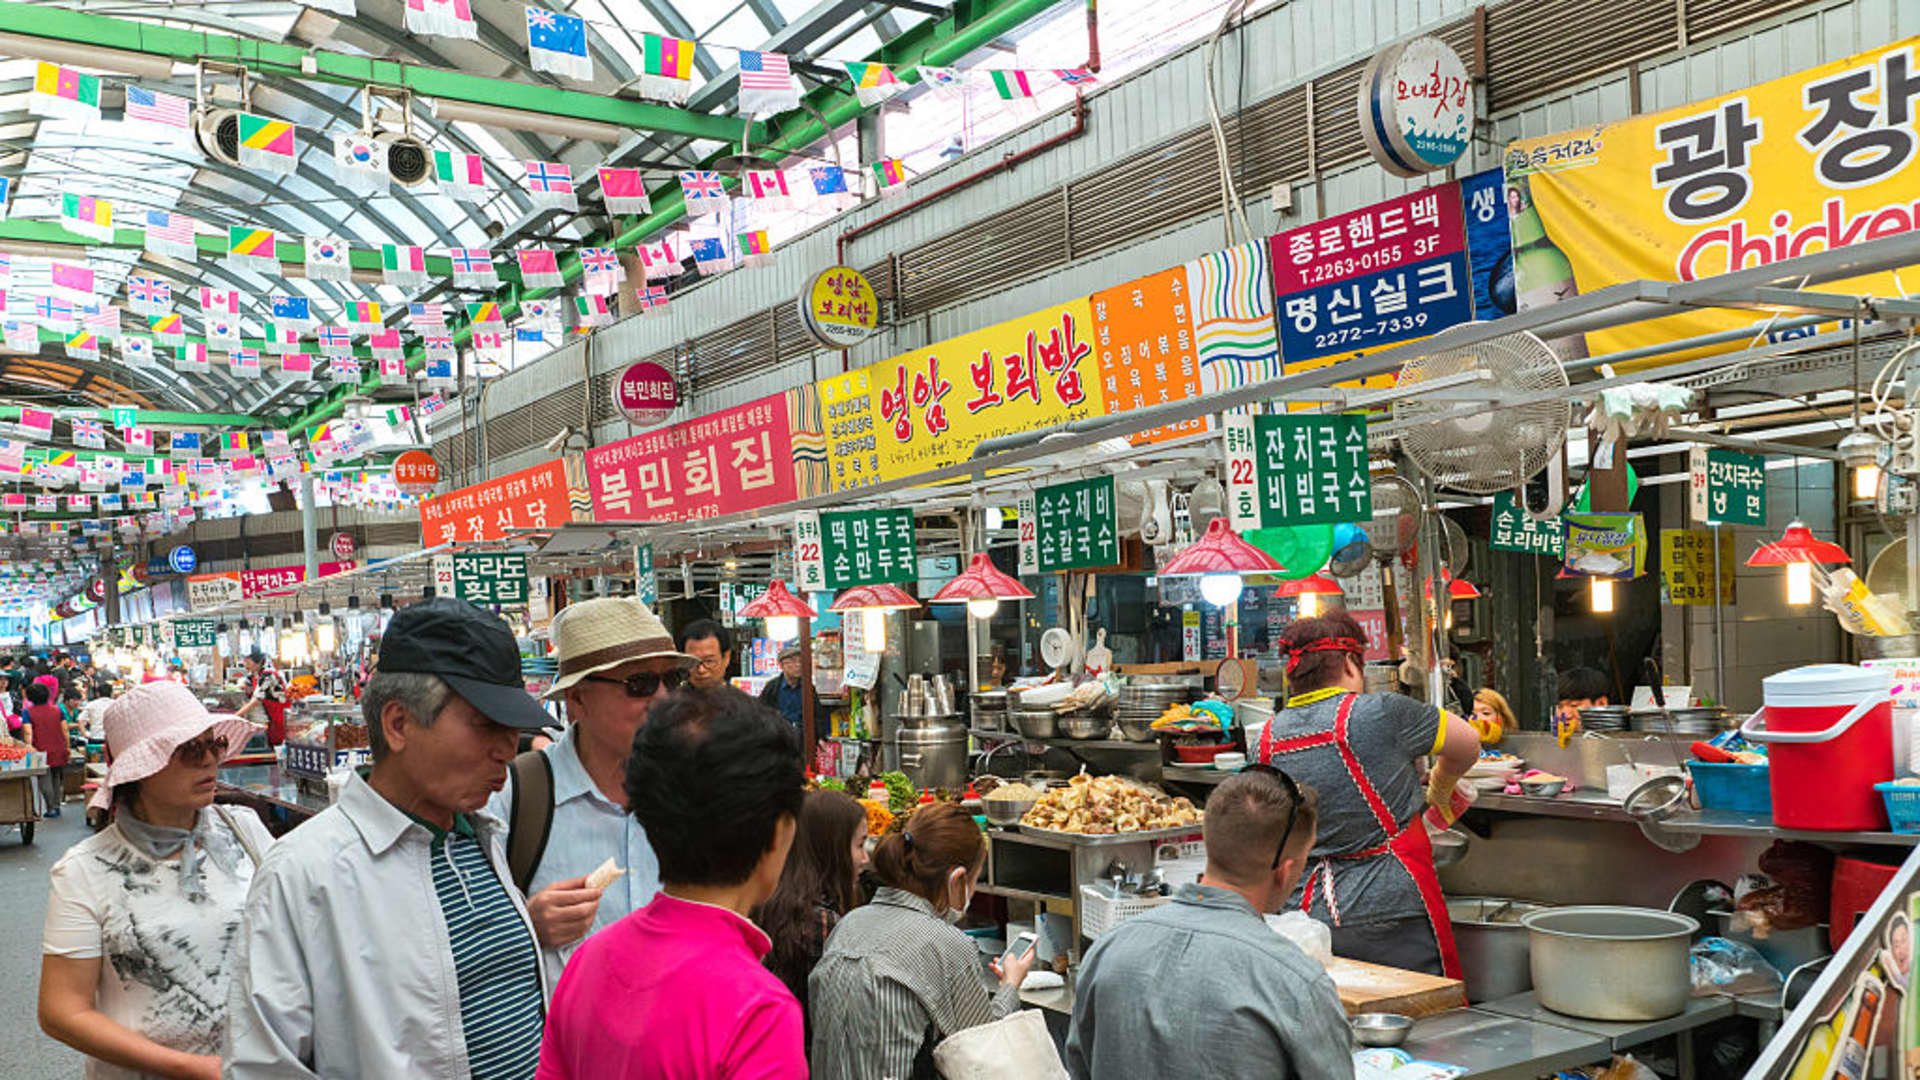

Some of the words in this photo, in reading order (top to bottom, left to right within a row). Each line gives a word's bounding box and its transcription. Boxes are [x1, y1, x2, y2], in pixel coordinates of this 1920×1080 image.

[1396, 60, 1469, 118] 모녀횟집
[1289, 194, 1439, 265] 종로핸드백
[1677, 197, 1920, 282] Chicke
[1413, 234, 1440, 256] 3F
[827, 272, 864, 298] 영암
[1285, 262, 1458, 333] 명신실크
[818, 300, 872, 325] 보리밥
[1315, 312, 1429, 348] 2272-7339
[623, 380, 674, 400] 복민회집
[880, 358, 951, 443] 영암
[966, 313, 1092, 414] 보리밥
[1265, 425, 1364, 470] 잔치국수
[398, 463, 436, 478] 광장식당
[600, 431, 775, 514] 복민회집
[1231, 459, 1254, 485] 22
[1710, 461, 1763, 490] 잔치국수
[1040, 485, 1110, 528] 손수제비
[1238, 491, 1255, 518] 호
[1268, 471, 1367, 517] 비빔국수
[440, 498, 547, 542] 광장식당
[831, 516, 910, 550] 떡만두국
[1021, 522, 1035, 542] 22
[800, 543, 820, 561] 22
[1024, 545, 1035, 566] 호
[1042, 523, 1113, 565] 손칼국수
[438, 571, 452, 582] 23
[455, 556, 525, 580] 전라도
[806, 564, 820, 584] 호
[834, 547, 914, 582] 손만두국
[464, 580, 521, 601] 횟집
